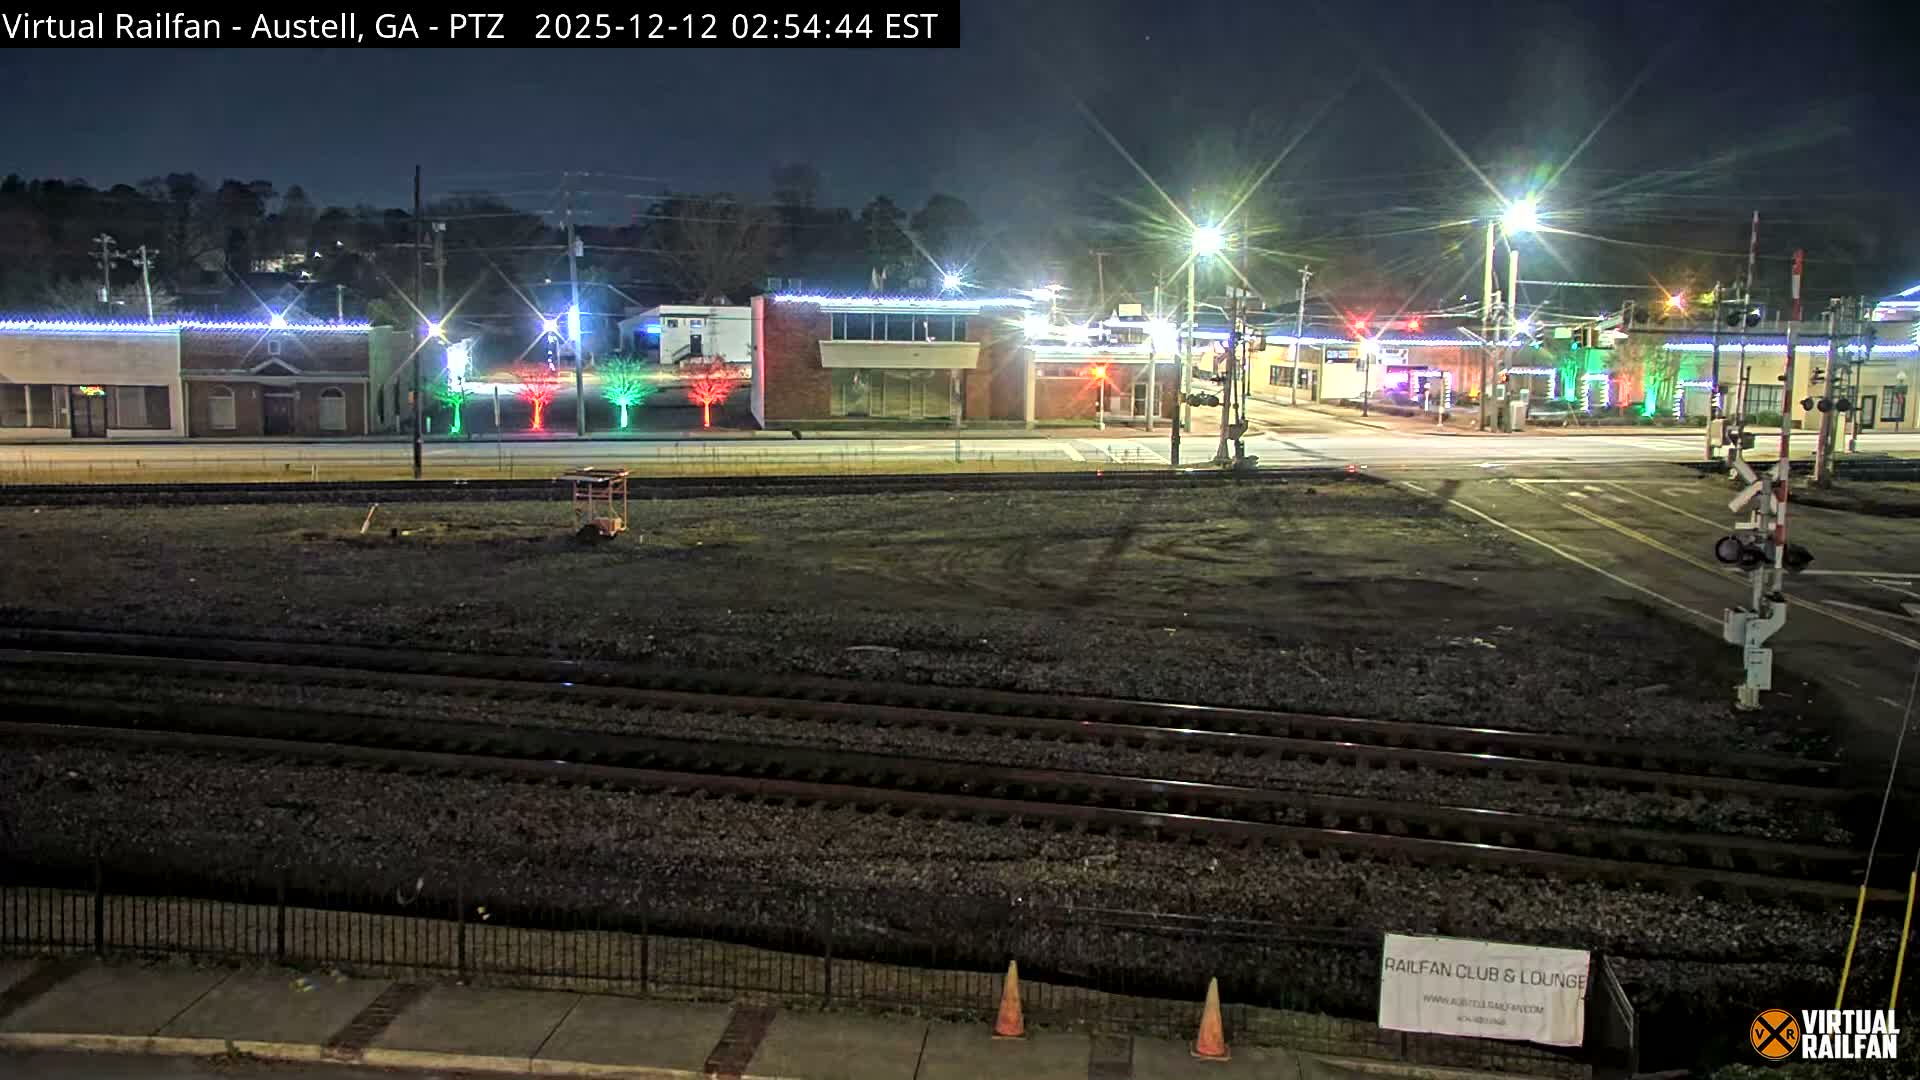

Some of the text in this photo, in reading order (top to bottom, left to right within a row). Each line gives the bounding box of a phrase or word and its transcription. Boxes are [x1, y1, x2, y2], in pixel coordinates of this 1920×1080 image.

[1385, 957, 1587, 990] RAILFAN CLUB & LOUNGE
